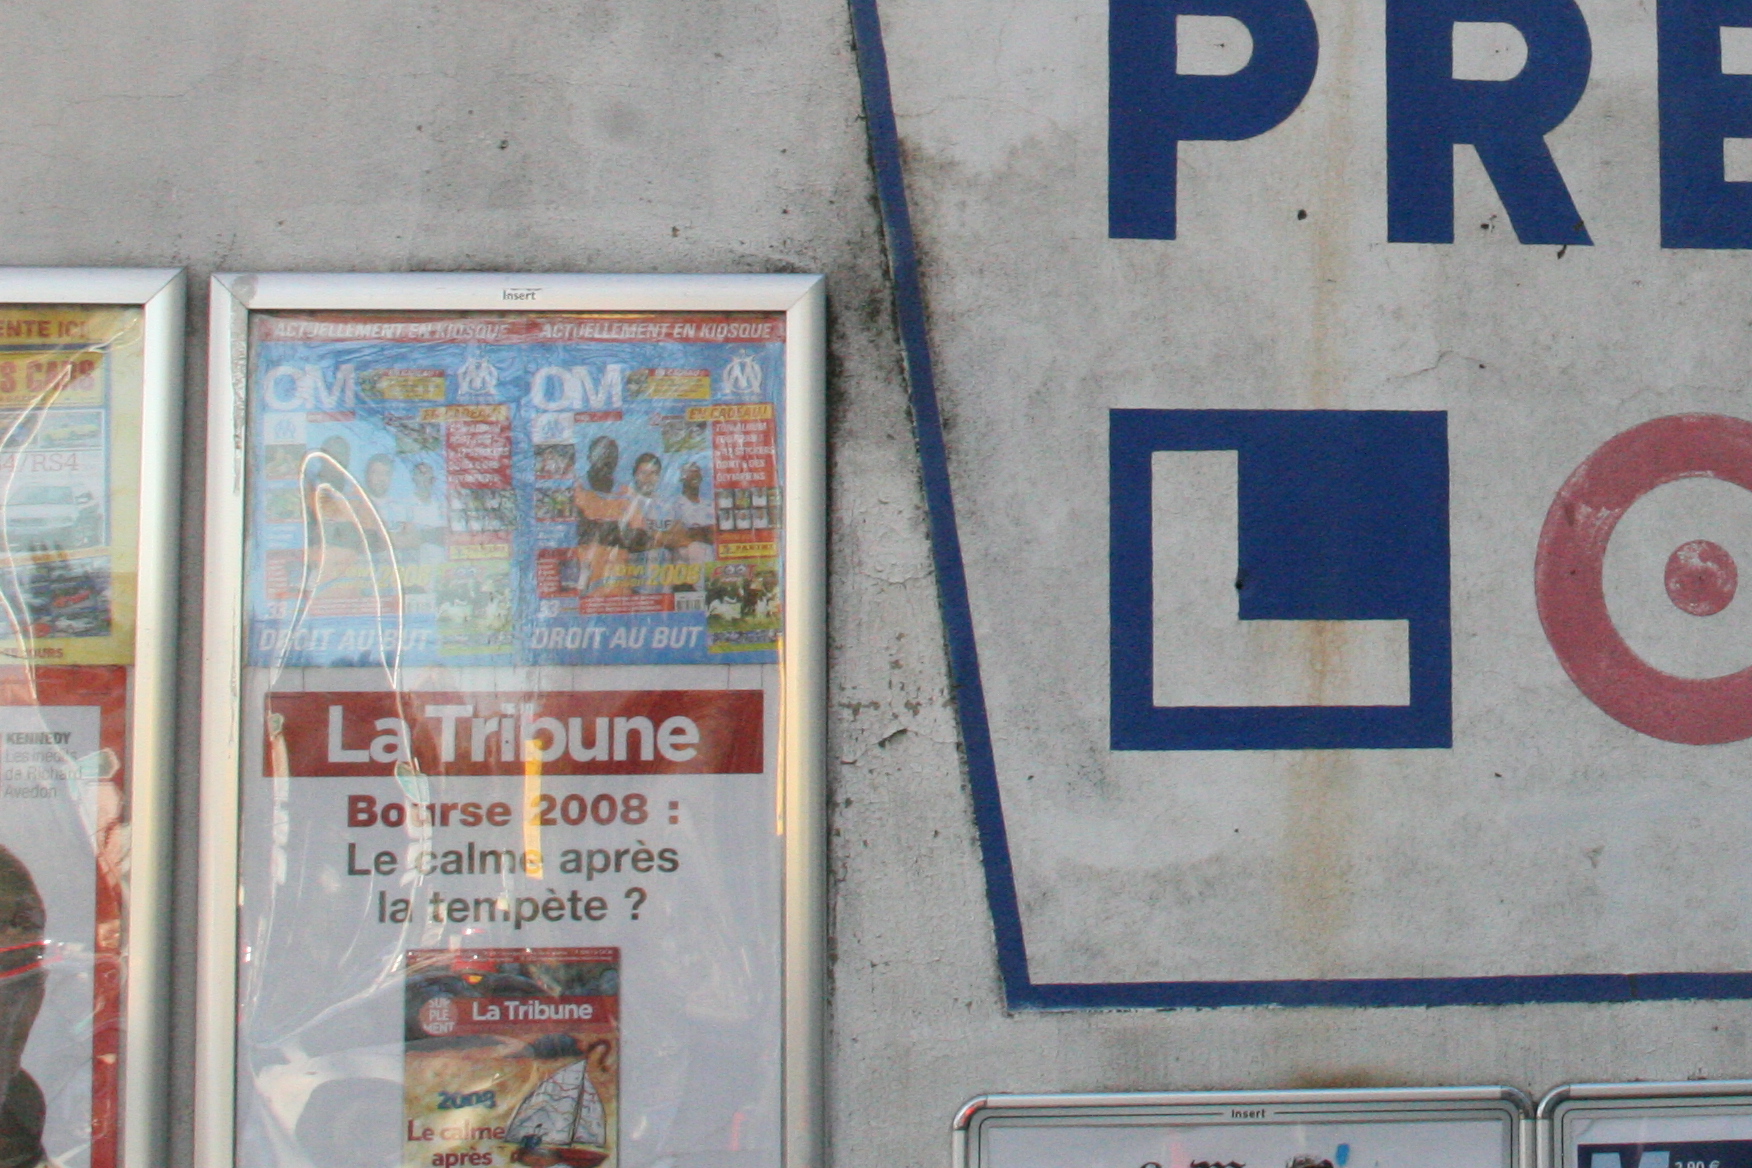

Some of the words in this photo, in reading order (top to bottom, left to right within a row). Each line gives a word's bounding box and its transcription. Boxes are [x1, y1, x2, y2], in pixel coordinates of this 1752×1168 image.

[502, 289, 536, 301] Insert
[539, 322, 672, 339] ACTUELLEMENT
[672, 322, 697, 338] EN
[699, 322, 773, 339] KIOSQUE
[264, 363, 356, 411] OM
[530, 363, 624, 411] OM
[531, 626, 607, 650] DROIT
[608, 626, 647, 650] AU
[650, 626, 705, 650] BUT
[327, 704, 413, 763] La
[424, 701, 700, 763] Tribune
[346, 794, 513, 828] Bourse
[528, 793, 649, 827] 2008
[346, 842, 398, 876] Le
[416, 841, 544, 875] calme
[559, 839, 680, 881] après
[378, 890, 413, 924] la
[428, 886, 609, 931] tempète
[623, 886, 648, 921] ?
[471, 1001, 501, 1021] La
[503, 1000, 593, 1020] Tribune
[1230, 1108, 1266, 1119] Insert
[407, 1119, 436, 1142] Le
[439, 1119, 508, 1141] calme
[431, 1145, 493, 1168] après
